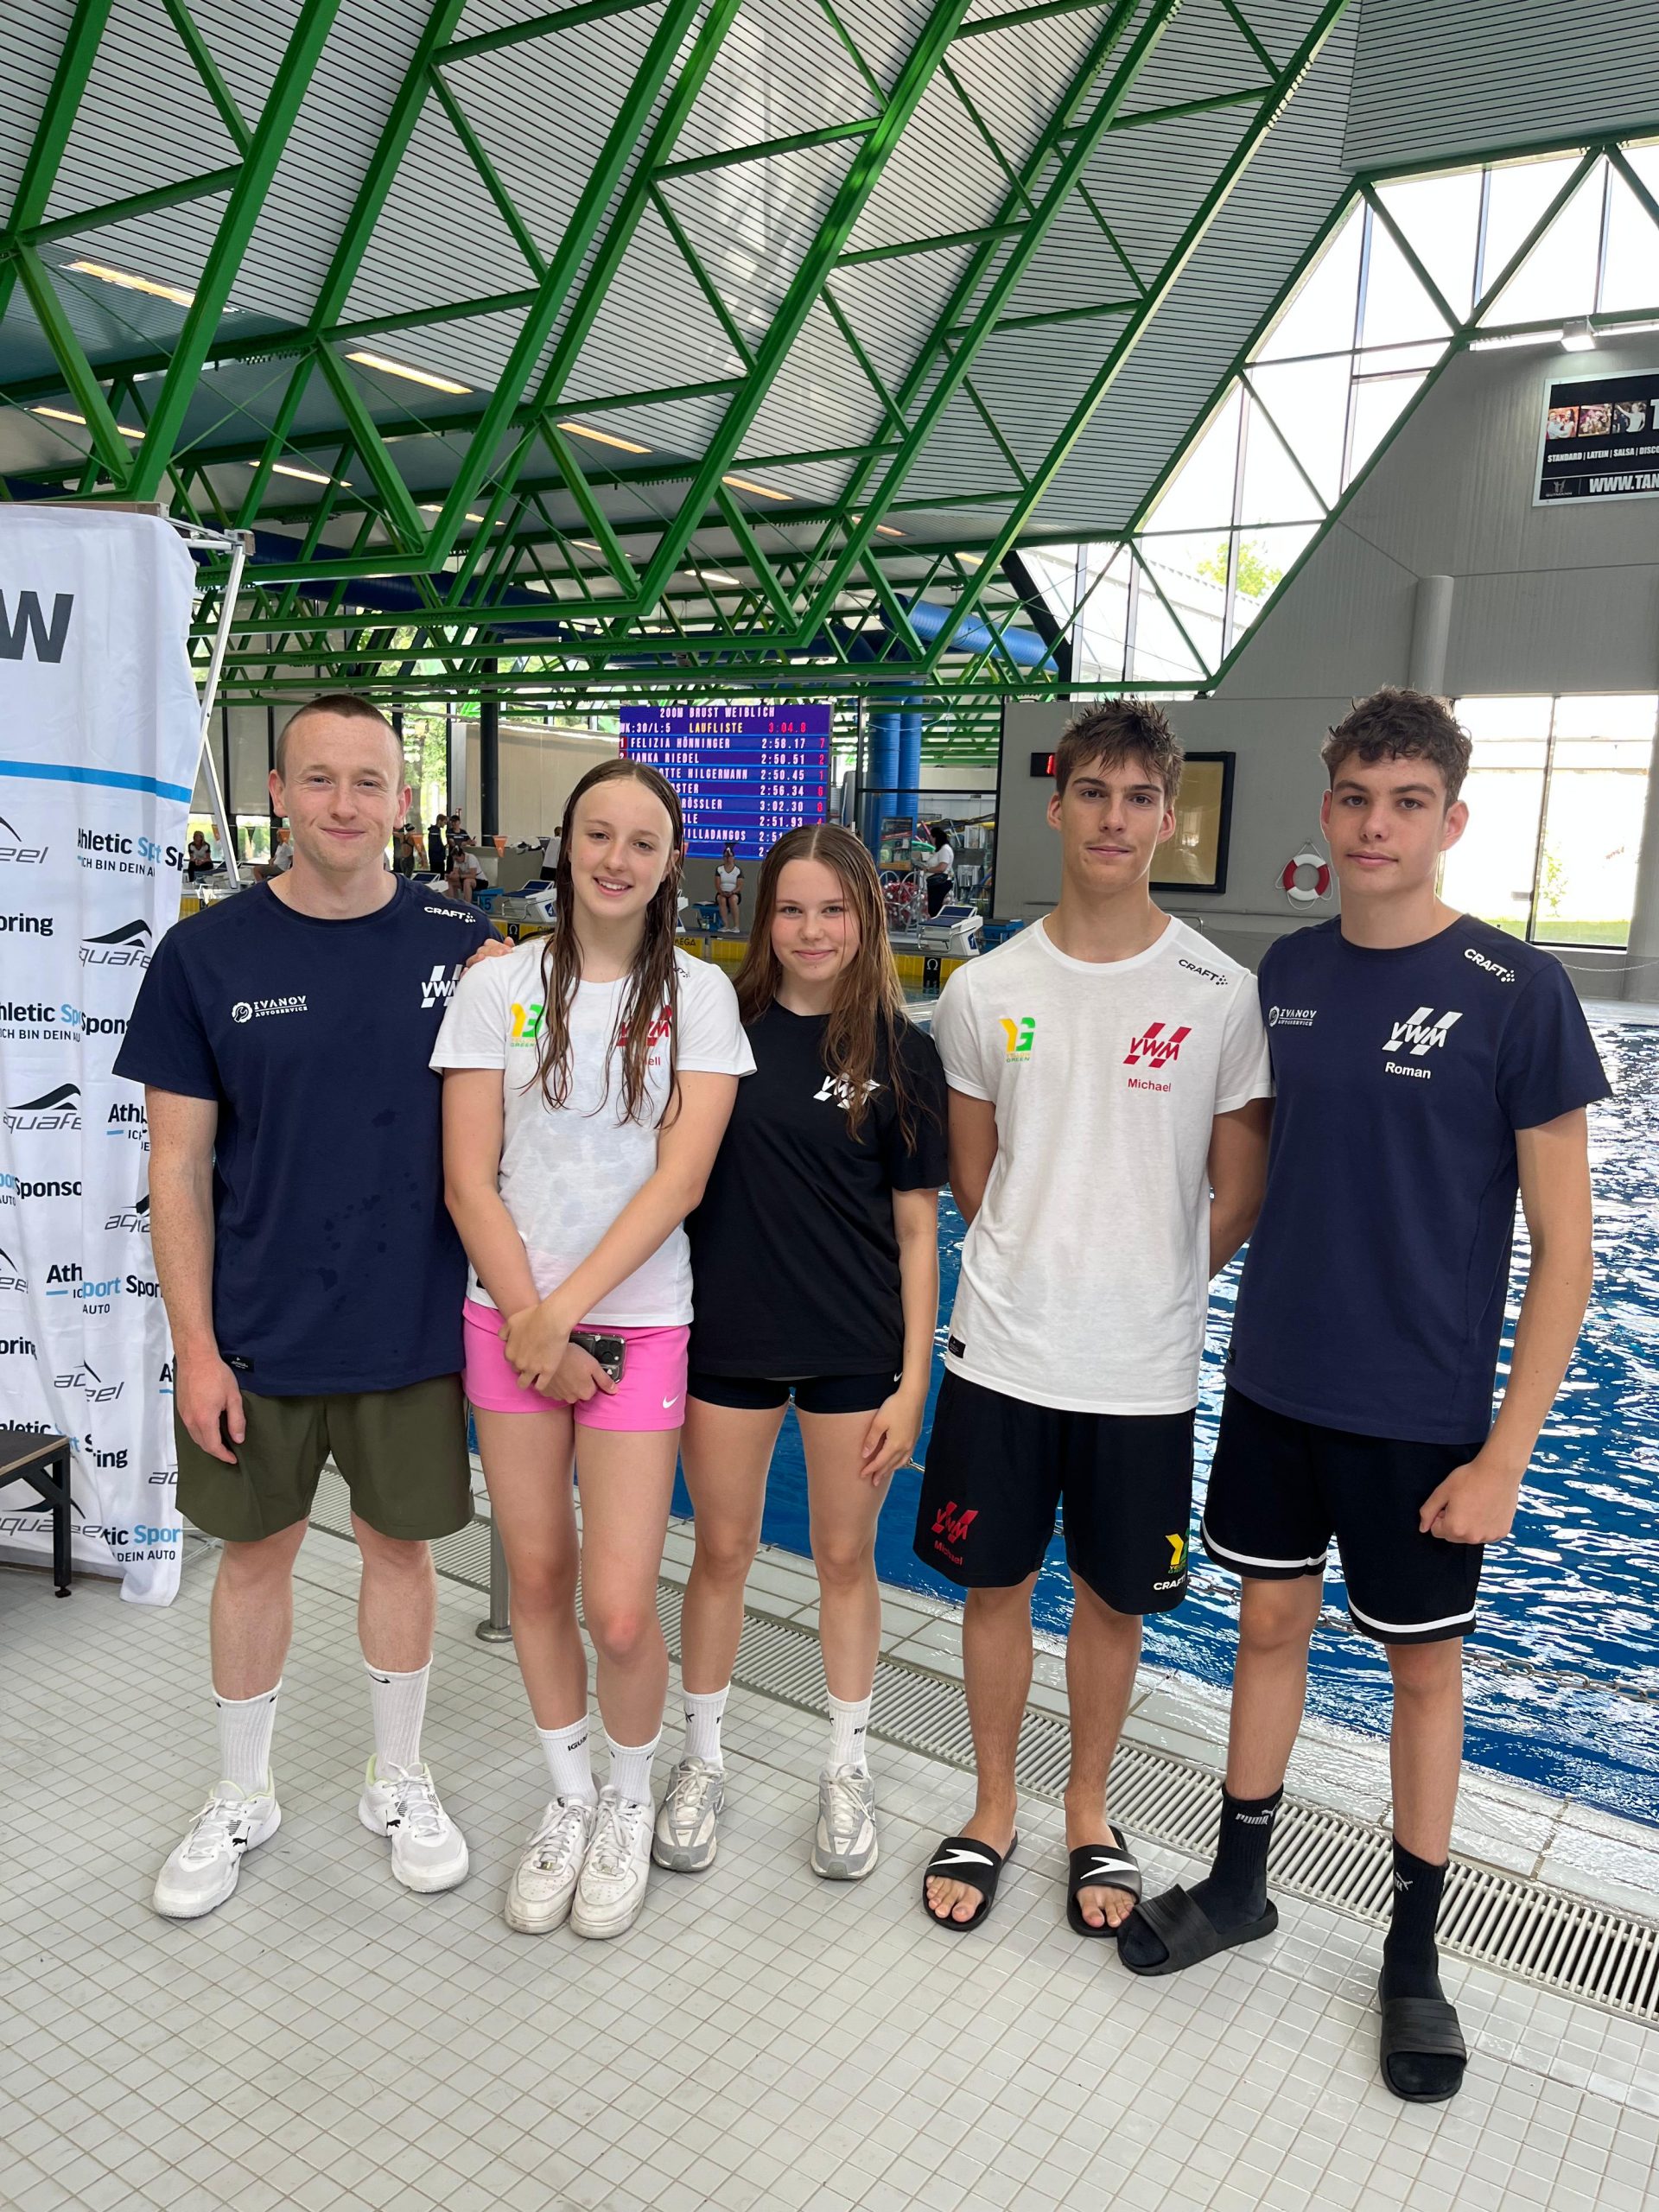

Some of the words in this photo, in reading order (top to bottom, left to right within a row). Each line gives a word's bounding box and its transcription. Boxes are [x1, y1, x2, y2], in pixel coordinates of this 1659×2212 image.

[1548, 452, 1582, 463] STANDARD
[1586, 449, 1609, 460] LATEIN
[1613, 448, 1635, 457] SALSA
[659, 707, 683, 718] 200M
[690, 707, 719, 718] BRUST
[724, 706, 775, 718] WEIBLICH
[689, 722, 743, 734] LAUFLISTE
[631, 737, 671, 749] FELIZIA
[677, 735, 730, 749] HÖNNINGER
[761, 737, 806, 749] 2:58.17
[664, 753, 699, 764] RIEDEL
[761, 753, 804, 765] 2:50.51
[819, 753, 824, 766] 2
[688, 767, 748, 779] HILGERMANN
[760, 769, 804, 781] 2:50.45
[760, 800, 804, 812] 3:02.30
[95, 859, 116, 871] BIN
[119, 861, 145, 874] DEIN
[424, 906, 467, 920] CRAFT
[1178, 958, 1219, 982] CRAFT
[1464, 948, 1507, 978] CRAFT
[253, 995, 307, 1009] IVANOV
[255, 1006, 308, 1018] AUTOSERVICE
[1279, 1008, 1318, 1019] IVANOV
[19, 1029, 40, 1039] BIN
[43, 1030, 71, 1040] DEIN
[1384, 1061, 1432, 1080] Roman
[1127, 1077, 1173, 1093] Michael
[147, 1550, 175, 1561] AUTO
[1235, 1812, 1269, 1826] PUMA
